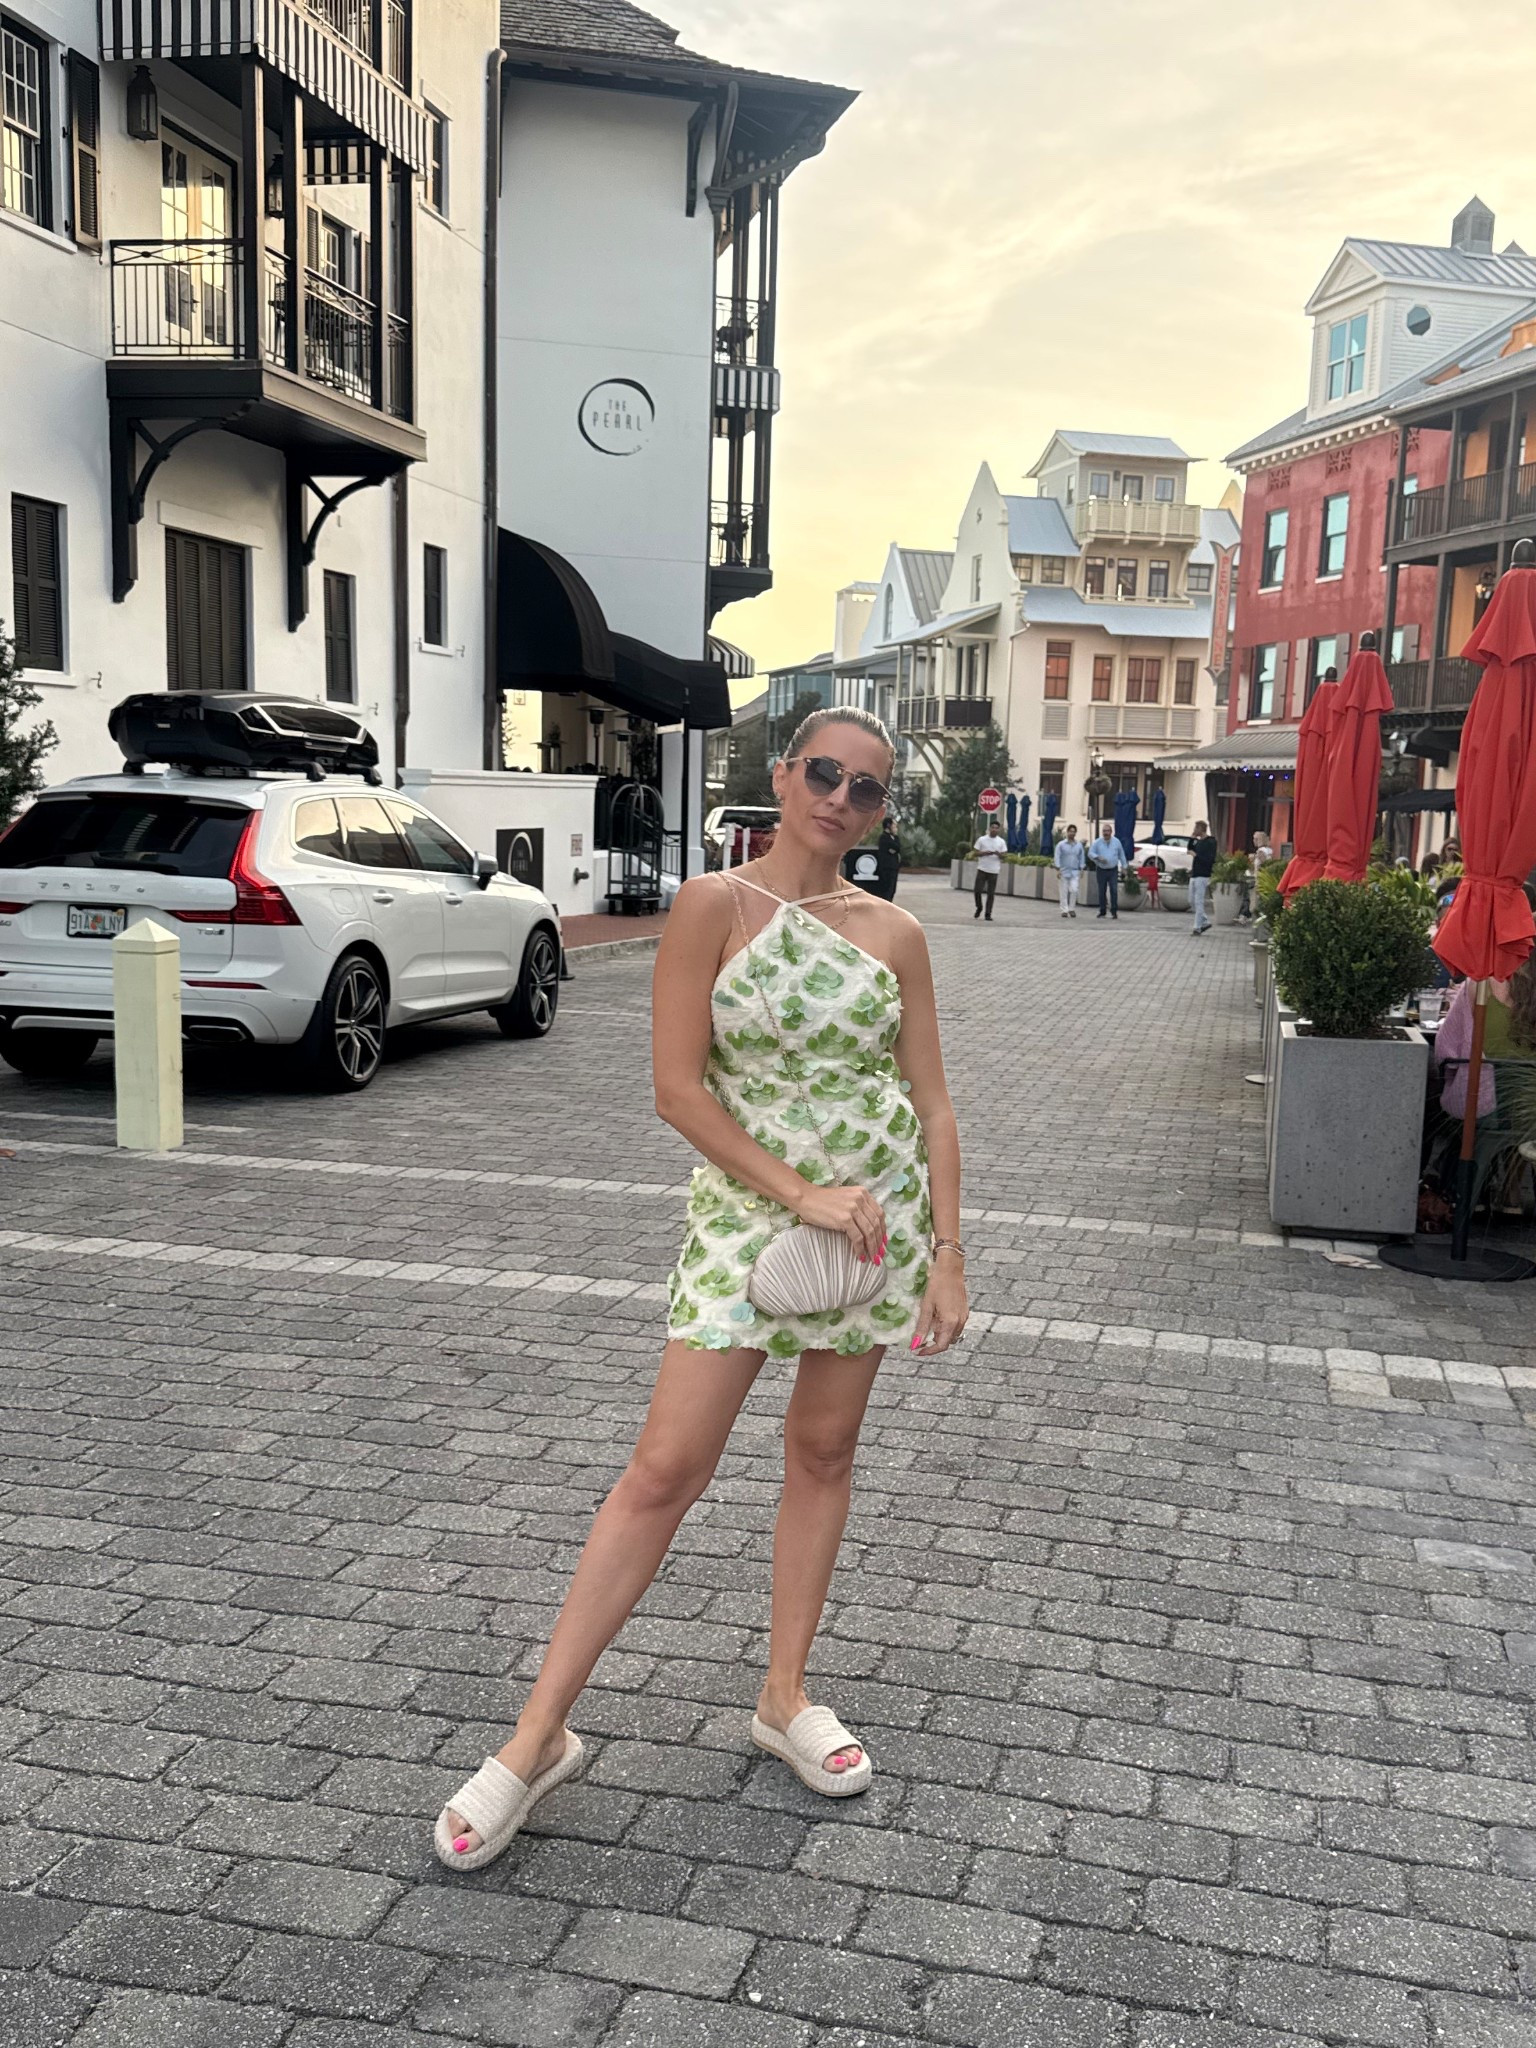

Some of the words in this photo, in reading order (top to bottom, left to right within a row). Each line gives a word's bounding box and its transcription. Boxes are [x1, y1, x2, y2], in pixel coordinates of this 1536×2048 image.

[608, 399, 627, 411] THE
[593, 411, 642, 431] PEARL
[980, 795, 1001, 805] STOP
